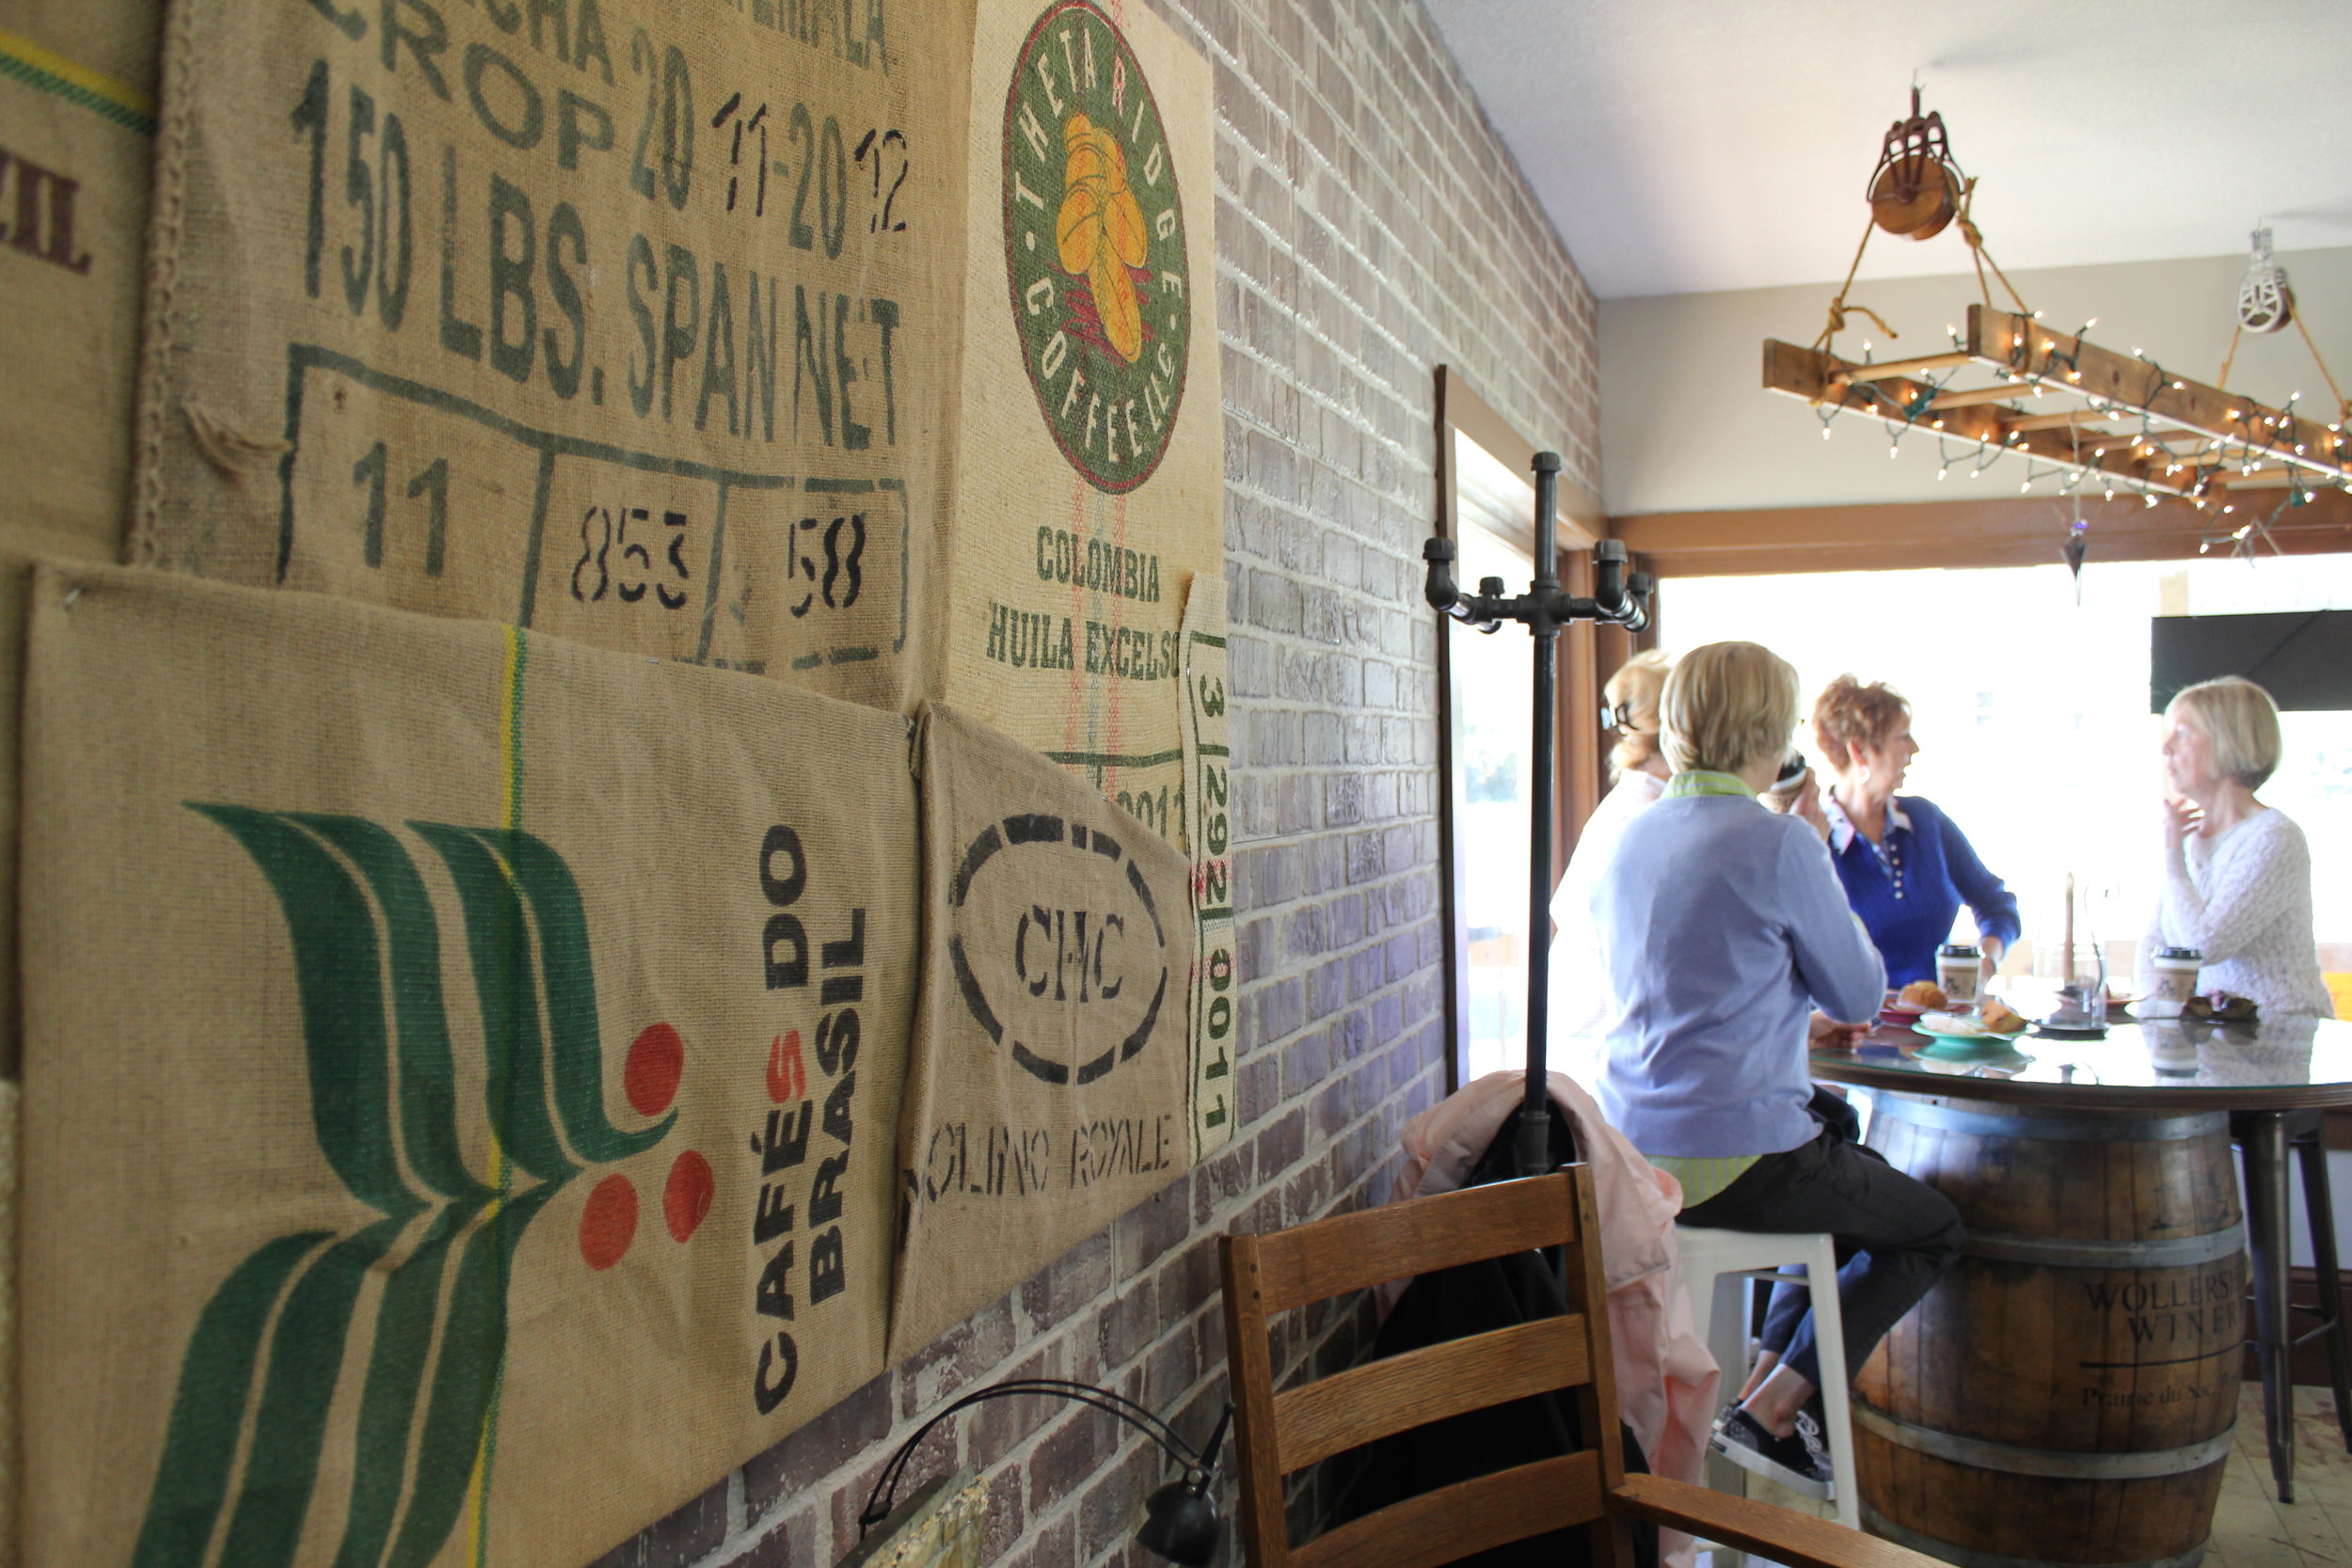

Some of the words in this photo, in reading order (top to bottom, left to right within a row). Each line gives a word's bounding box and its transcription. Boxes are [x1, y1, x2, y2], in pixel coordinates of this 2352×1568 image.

[292, 58, 411, 333] 150
[439, 145, 604, 408] LBS.
[1015, 27, 1097, 211] THETA
[1112, 55, 1184, 299] RIDGE
[1026, 277, 1144, 463] COFFEE
[352, 441, 449, 578] 11
[571, 506, 690, 610] 853
[787, 513, 867, 619] 58
[1036, 525, 1161, 603] COLOMBIA
[986, 601, 1074, 671] HUILA
[1085, 620, 1181, 681] EXCELSO
[1200, 673, 1225, 718] 3
[759, 824, 809, 990] DO
[1206, 763, 1229, 906] 292
[1015, 904, 1124, 1004] CHC
[808, 908, 866, 1306] BRASIL
[1205, 947, 1232, 1129] 0011
[750, 1028, 812, 1415] CAFÉS
[1070, 1113, 1171, 1189] ROYALE
[2084, 1270, 2236, 1312] WOLLERS
